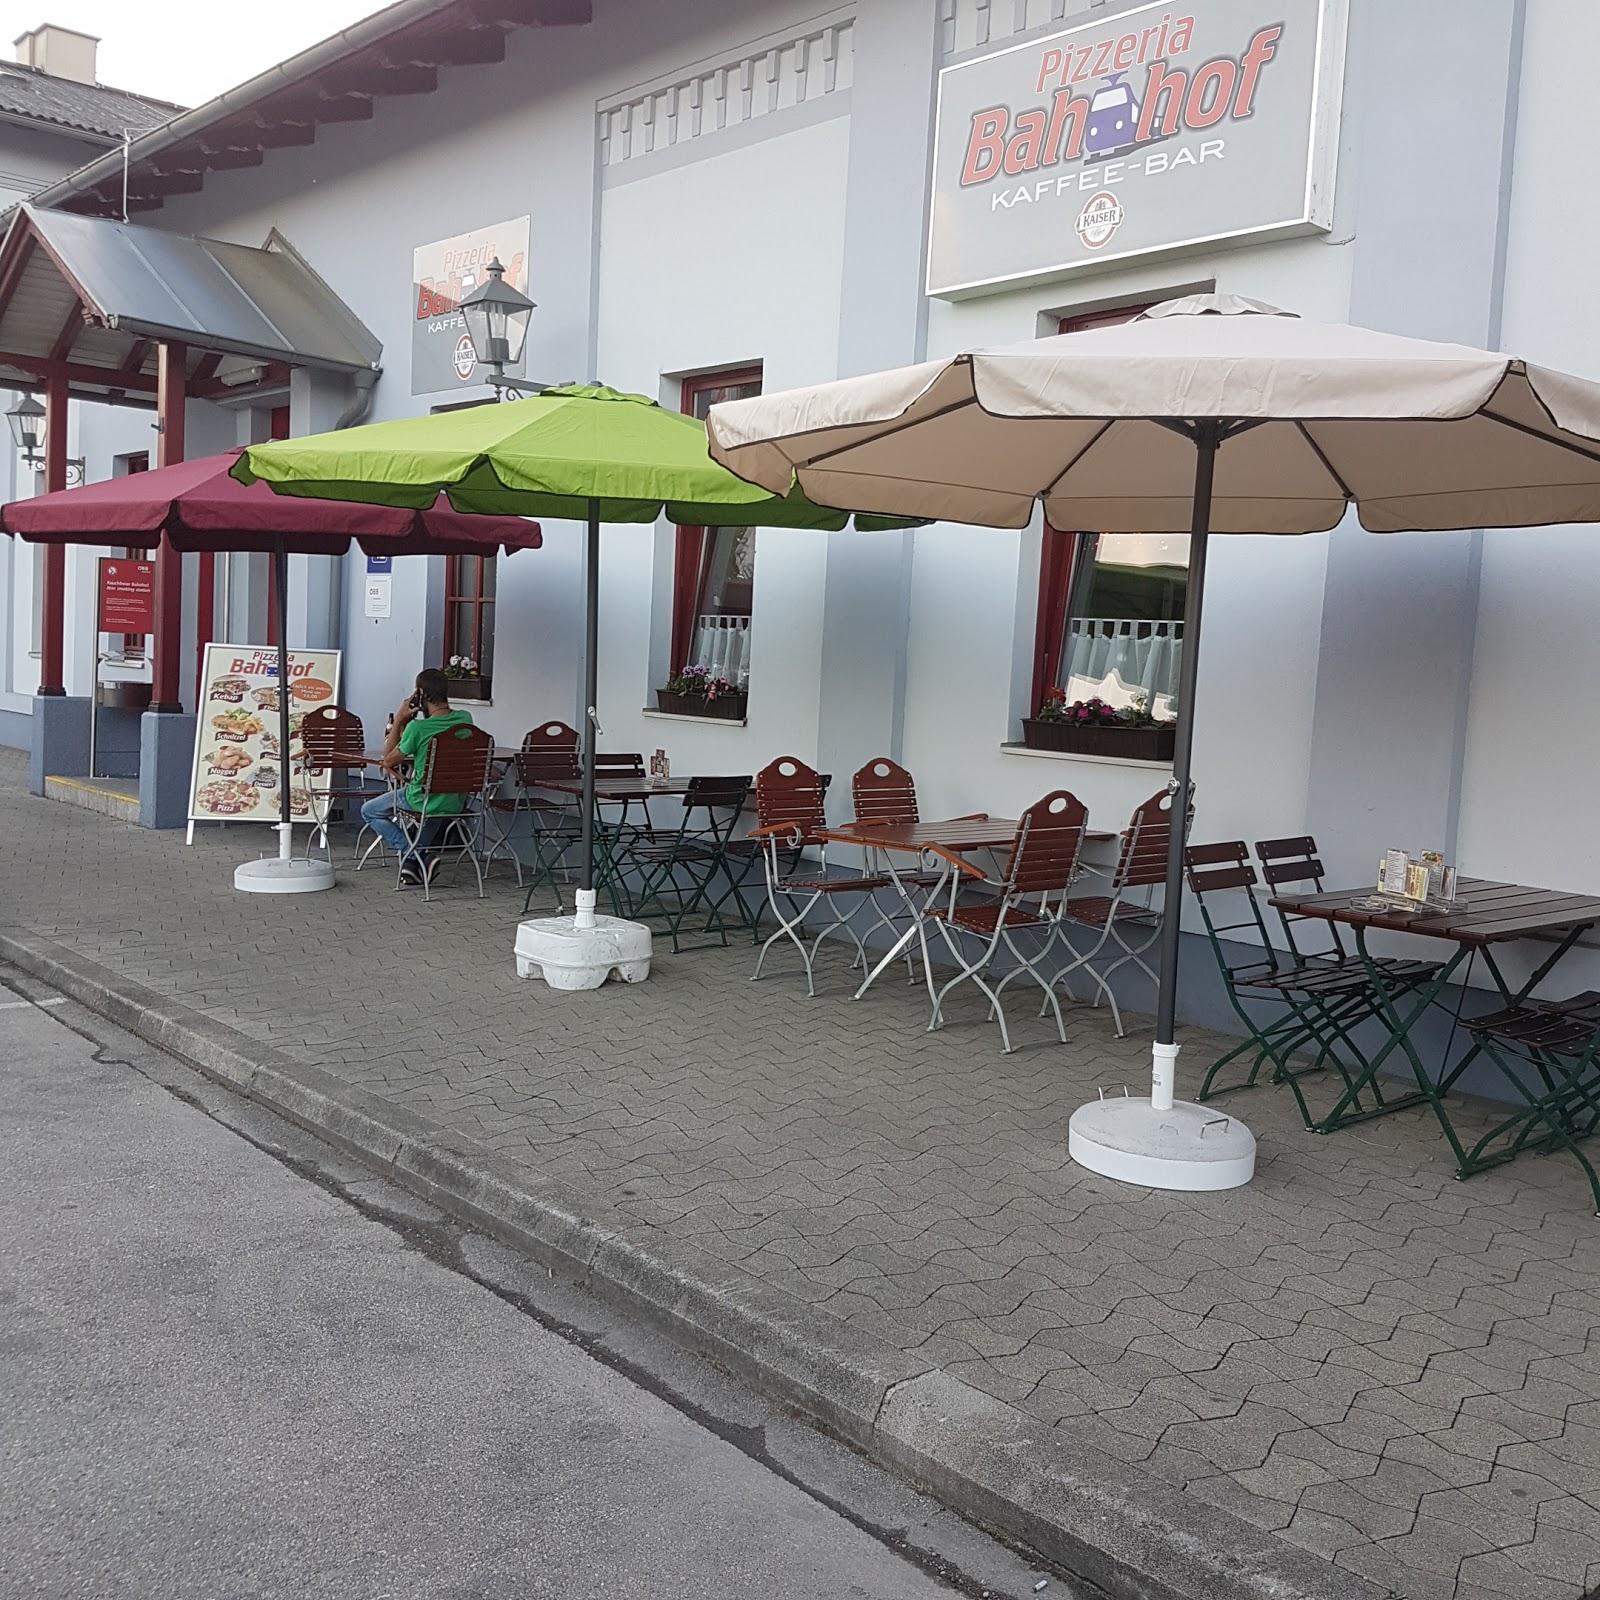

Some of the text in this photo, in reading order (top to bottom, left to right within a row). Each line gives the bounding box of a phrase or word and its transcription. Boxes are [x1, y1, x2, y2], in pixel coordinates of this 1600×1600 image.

[1035, 12, 1196, 93] Pizzeria
[990, 139, 1226, 212] KAFFEE-BAR
[1083, 209, 1116, 228] KAISER
[443, 240, 497, 273] Pizzeria
[427, 316, 466, 334] KAFFE
[252, 651, 295, 663] Pizzea
[212, 692, 239, 701] Kebap
[216, 733, 246, 741] Schnitzel
[216, 804, 235, 812] Pizza
